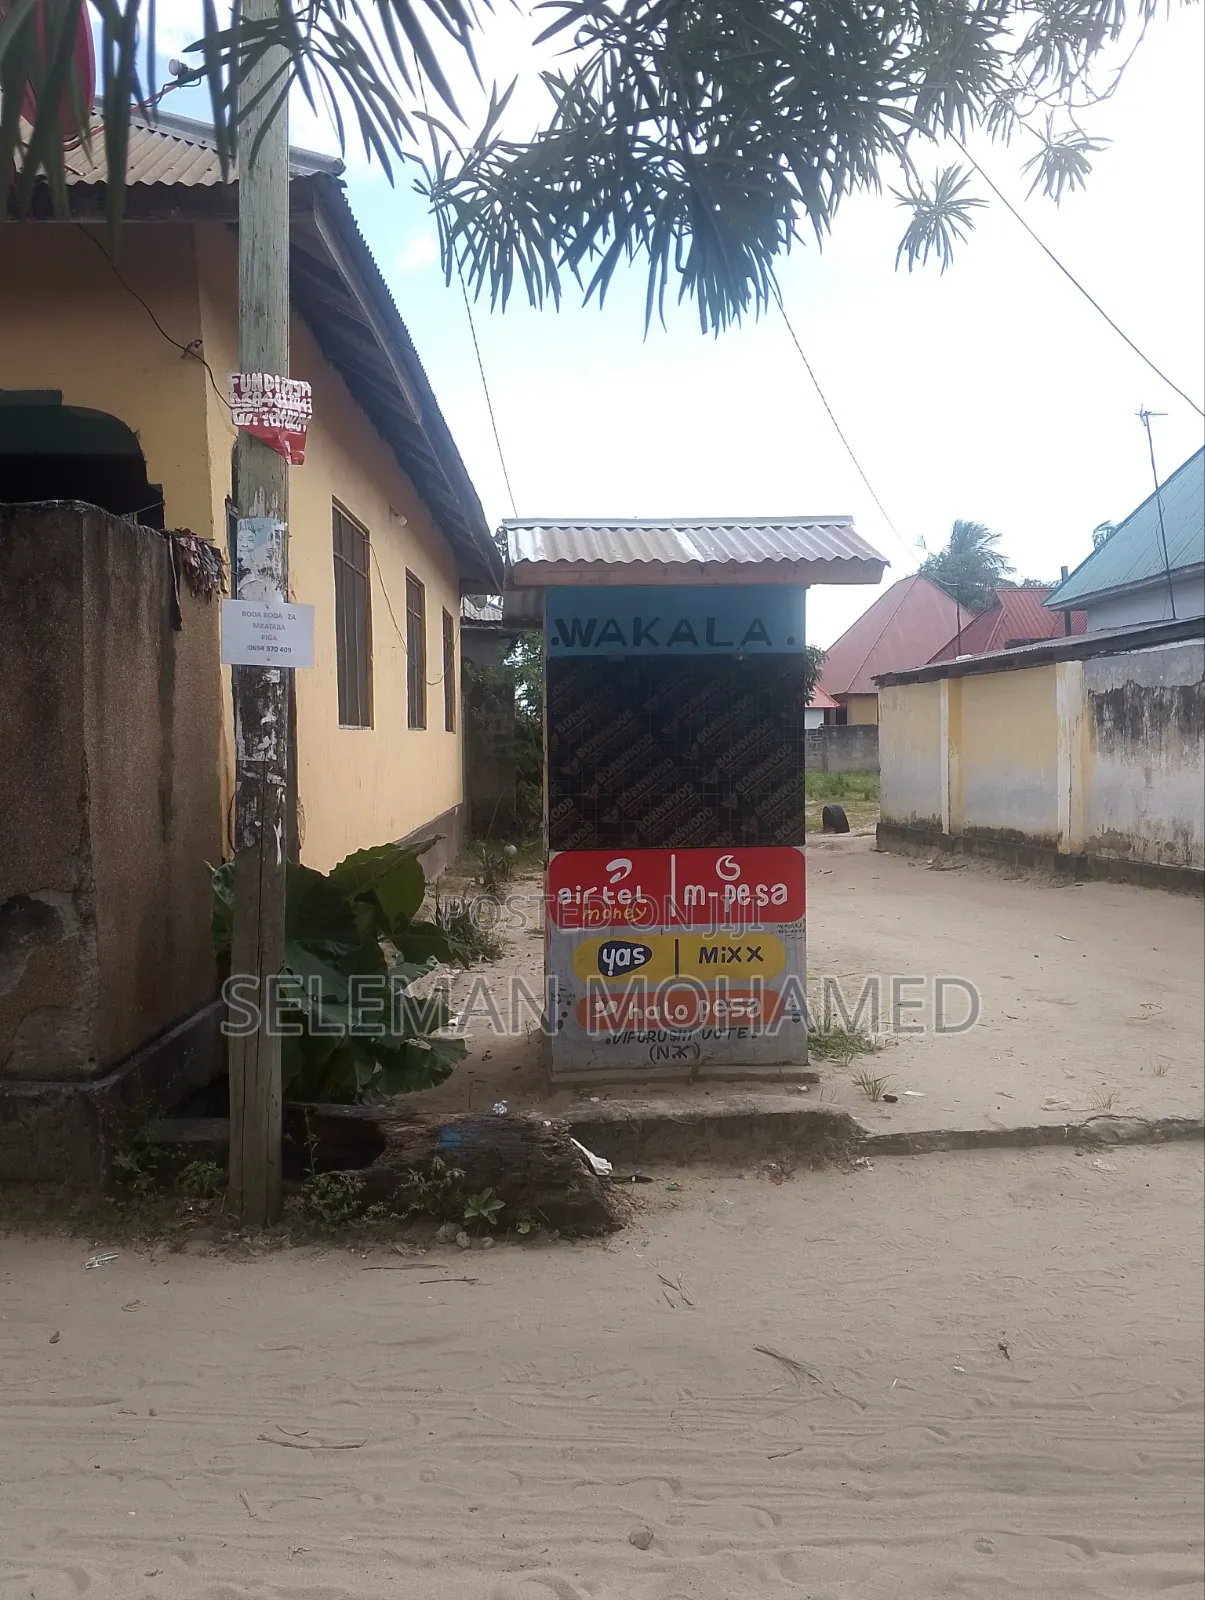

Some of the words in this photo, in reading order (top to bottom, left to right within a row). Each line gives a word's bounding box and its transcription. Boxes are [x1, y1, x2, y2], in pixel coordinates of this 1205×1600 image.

[252, 622, 286, 631] MKATABA
[287, 613, 297, 621] ZA
[266, 645, 279, 653] 970
[577, 708, 634, 758] BOOOD
[716, 718, 773, 768] BORNWOOD
[597, 732, 653, 783] BORNWOOD
[735, 743, 792, 792] BORNWOOD
[637, 782, 694, 832] BORNWOOD
[558, 885, 648, 905] airtel
[683, 883, 788, 913] m-pesa
[583, 905, 648, 923] money
[602, 947, 646, 977] yas
[628, 1001, 688, 1020] halo
[698, 997, 761, 1023] pesa
